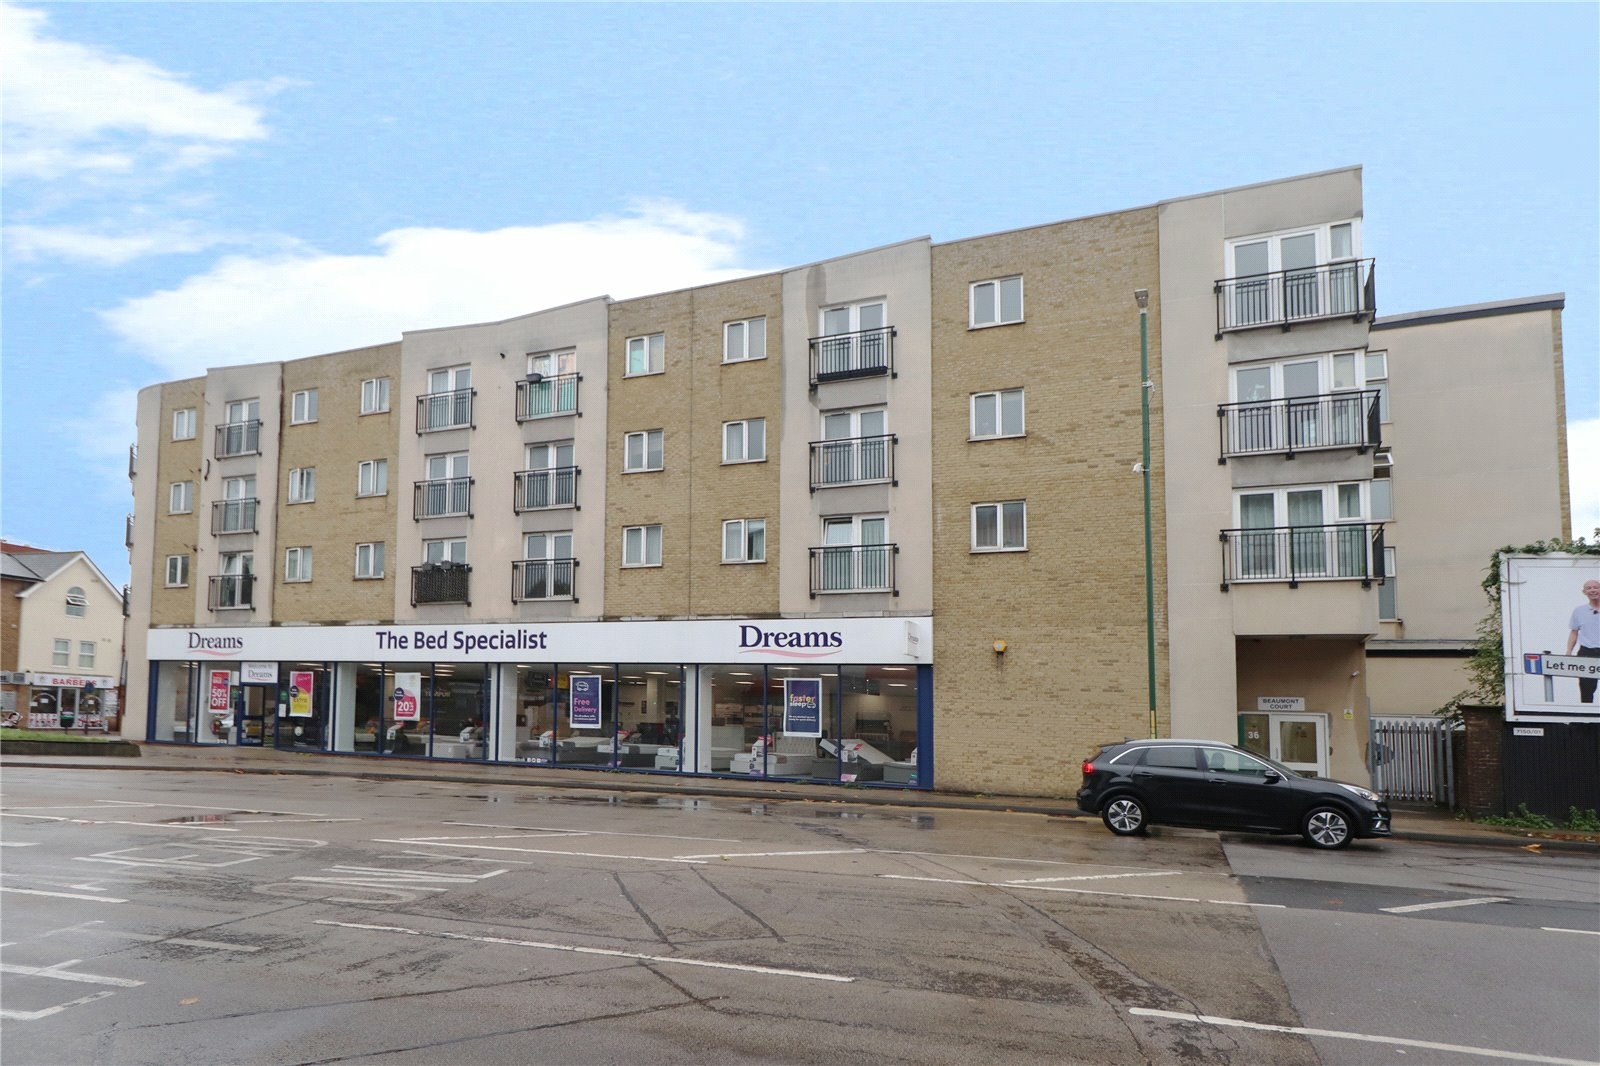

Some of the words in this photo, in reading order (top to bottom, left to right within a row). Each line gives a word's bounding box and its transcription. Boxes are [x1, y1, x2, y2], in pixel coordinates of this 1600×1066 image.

[187, 631, 244, 649] Dreams
[376, 631, 409, 650] The
[414, 630, 447, 650] Bed
[453, 629, 548, 654] Specialist
[739, 625, 843, 648] Dreams
[1546, 660, 1566, 671] Let
[1567, 664, 1586, 672] me
[248, 670, 273, 678] Dreams
[212, 688, 227, 698] 50%
[790, 693, 816, 702] faster
[211, 697, 227, 707] OFF
[573, 697, 591, 706] Free
[573, 706, 597, 714] Delivery
[1248, 731, 1260, 739] 36
[253, 850, 533, 904] ONLY
